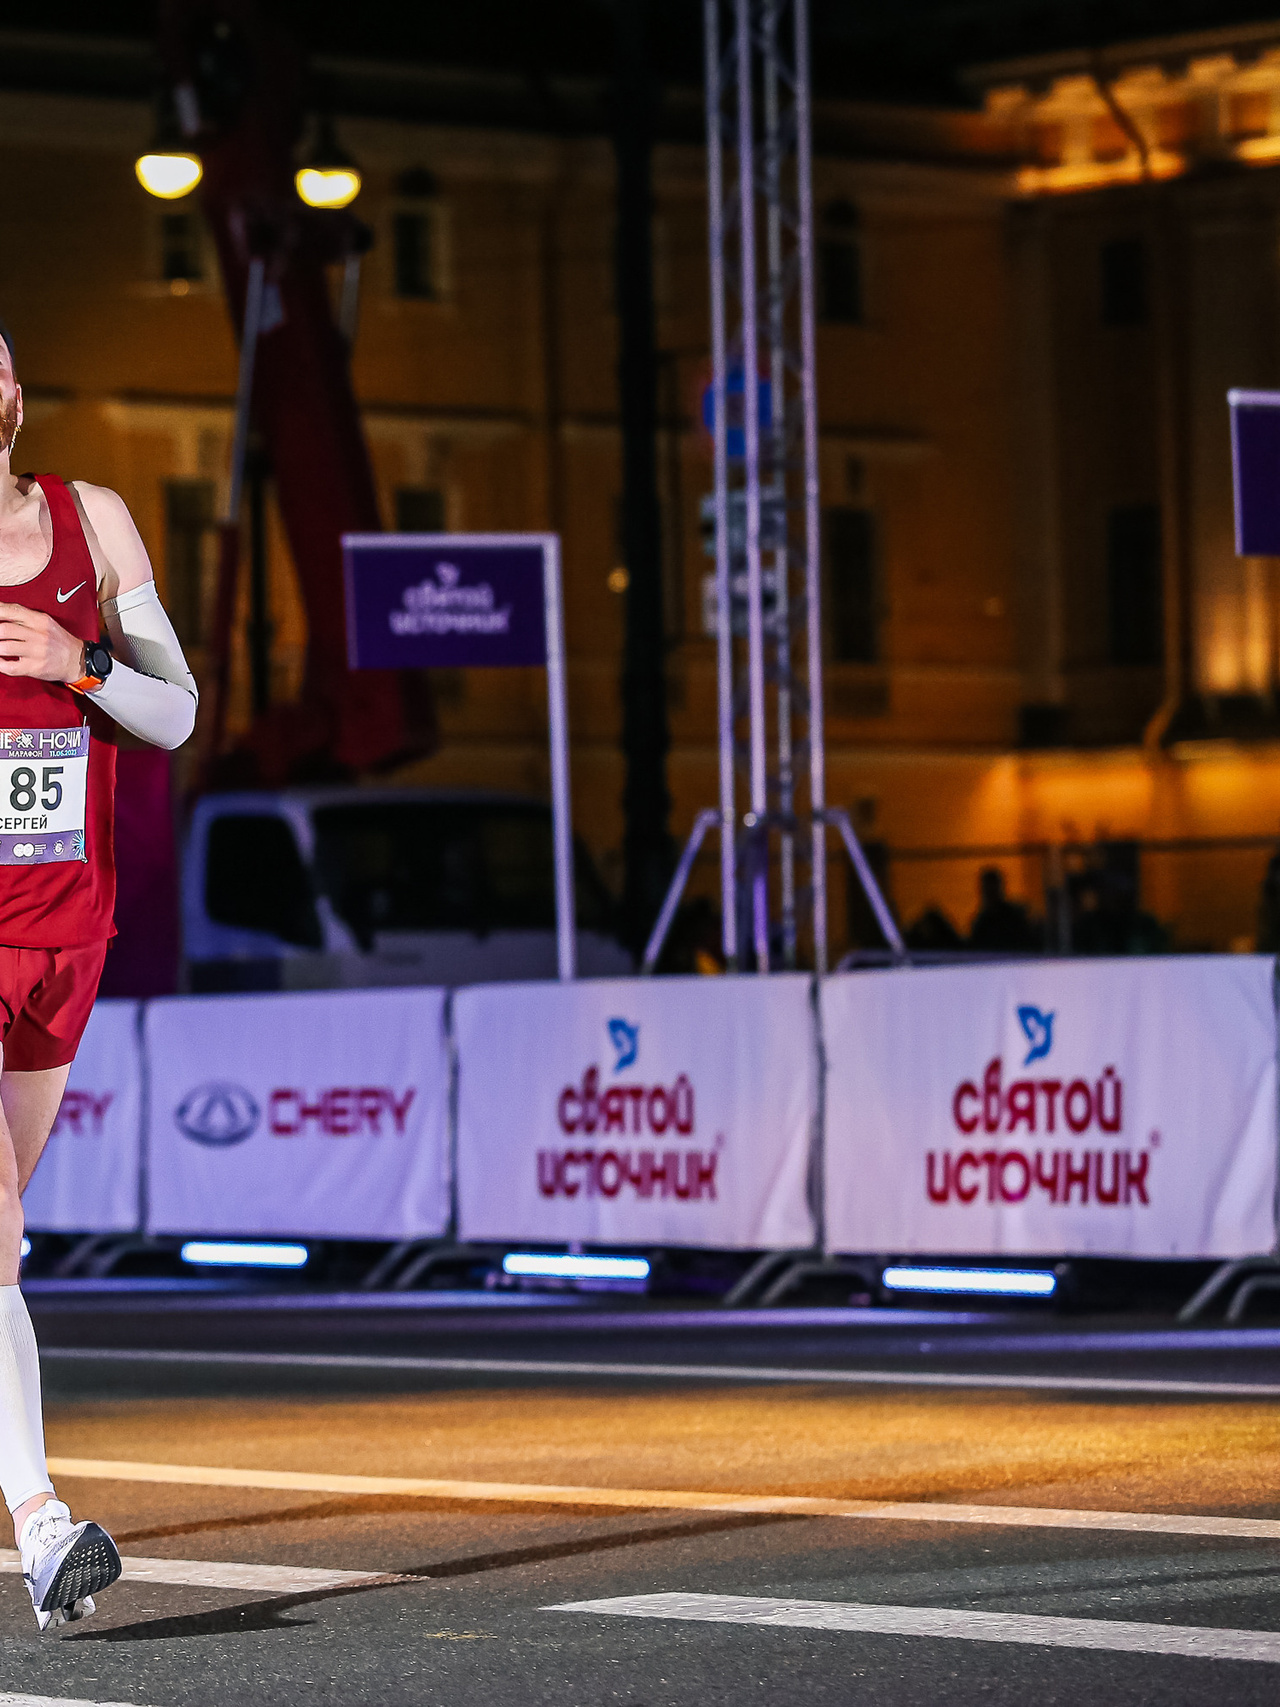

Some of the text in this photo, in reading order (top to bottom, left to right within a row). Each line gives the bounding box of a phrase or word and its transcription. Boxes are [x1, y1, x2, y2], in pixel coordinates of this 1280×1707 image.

[39, 730, 81, 749] НОЧИ
[8, 750, 43, 758] МАРАФОН
[269, 1086, 417, 1137] CHERY
